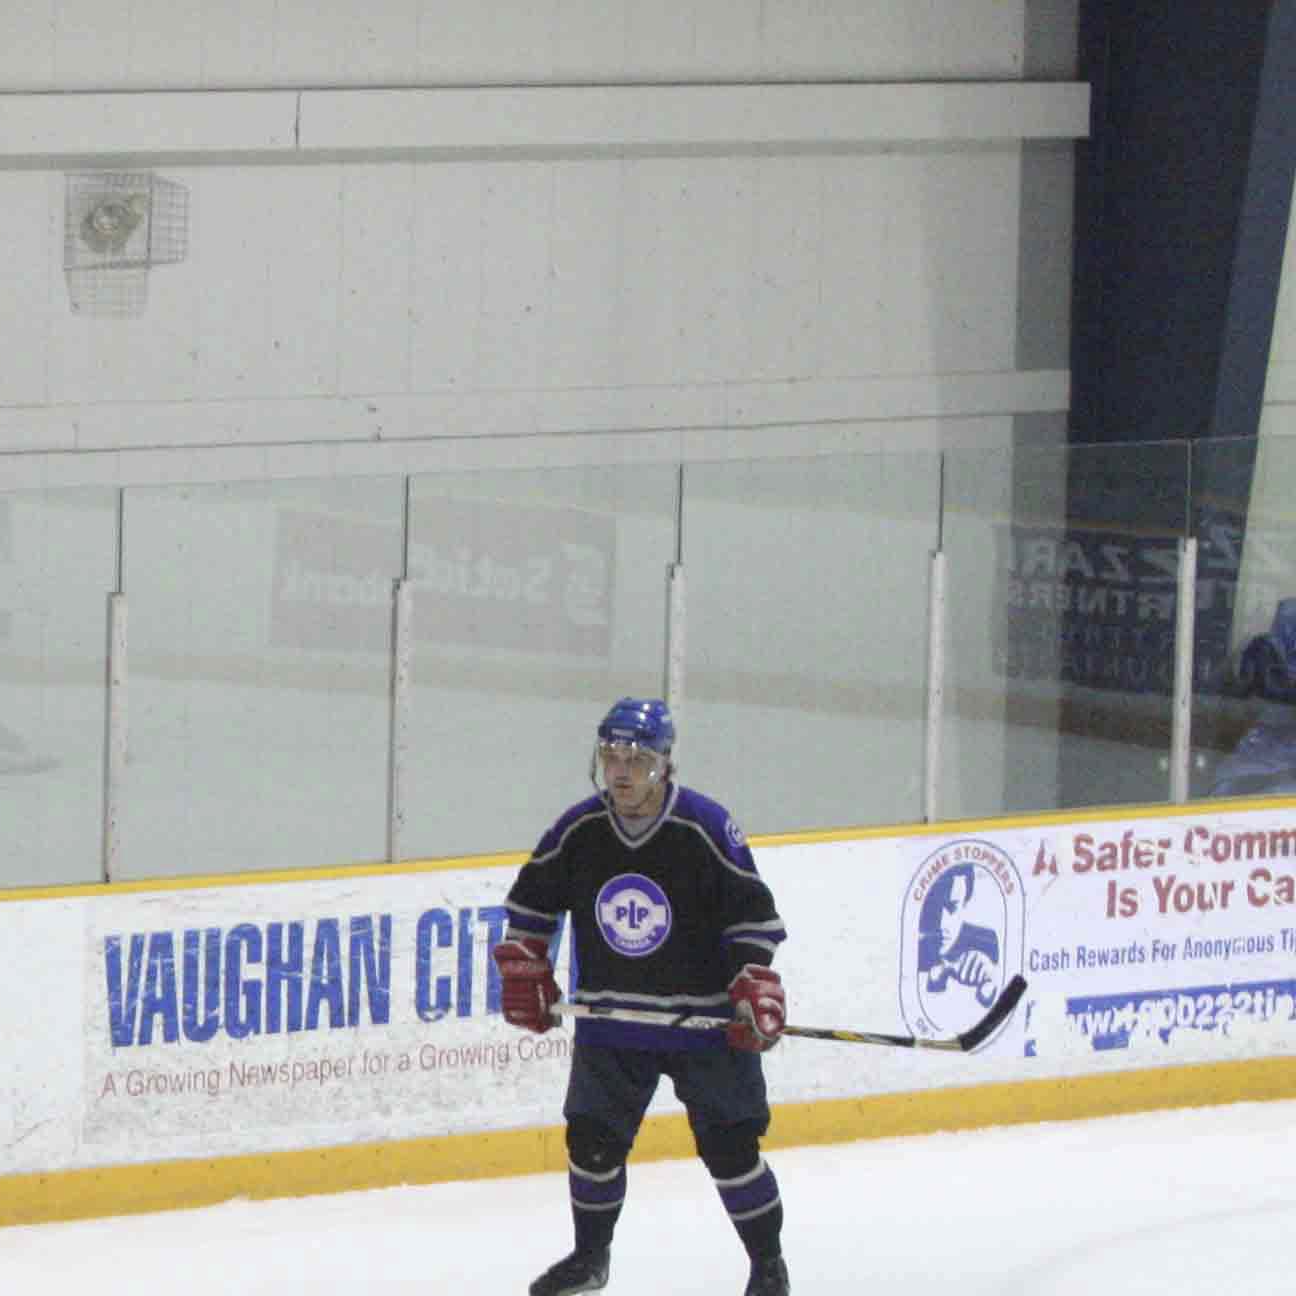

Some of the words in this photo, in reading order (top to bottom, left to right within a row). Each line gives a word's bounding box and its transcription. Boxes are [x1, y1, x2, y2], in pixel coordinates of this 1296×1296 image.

[1072, 831, 1171, 875] Safer
[615, 900, 649, 929] PLP
[1106, 880, 1138, 918] Is
[1152, 875, 1235, 914] Your
[104, 912, 393, 1048] VAUGHAN
[414, 905, 524, 1025] CIT
[1030, 949, 1069, 972] Cash
[1077, 941, 1145, 968] Rewards
[1152, 940, 1177, 963] For
[102, 1072, 118, 1097] A
[126, 1064, 221, 1097] Growing
[229, 1056, 354, 1093] Newspaper
[361, 1052, 389, 1076] for
[397, 1055, 410, 1072] a
[419, 1040, 510, 1074] Growing
